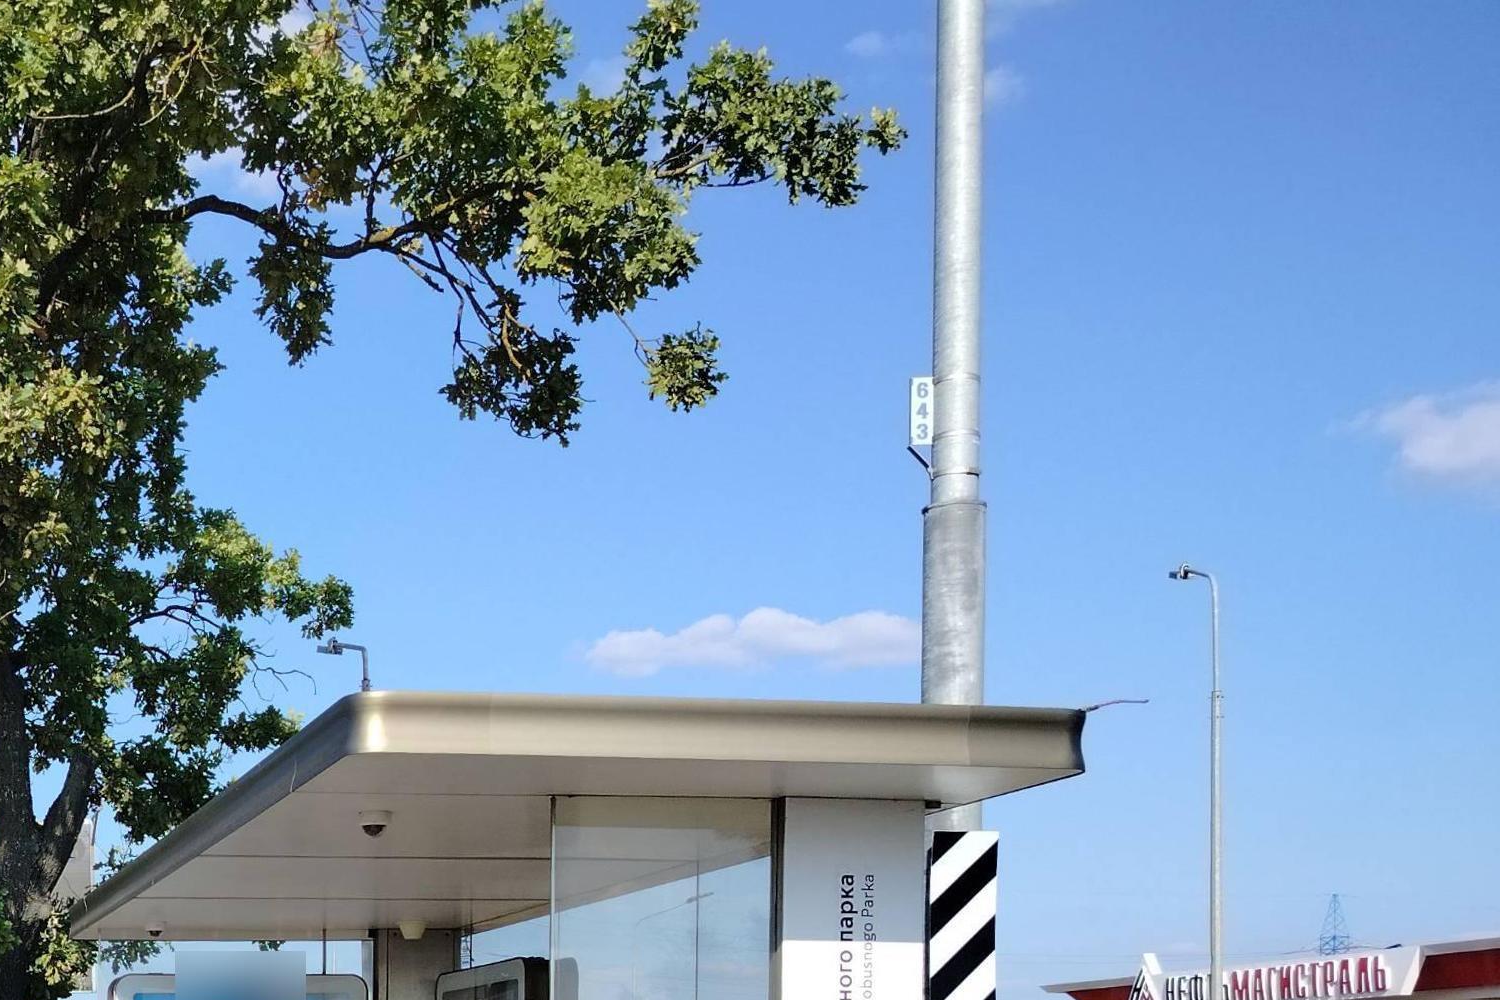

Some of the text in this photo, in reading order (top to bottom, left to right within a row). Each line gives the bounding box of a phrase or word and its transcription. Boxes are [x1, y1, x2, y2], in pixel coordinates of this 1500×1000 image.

[916, 382, 929, 440] 643
[839, 874, 859, 942] парка
[861, 874, 875, 917] Parka
